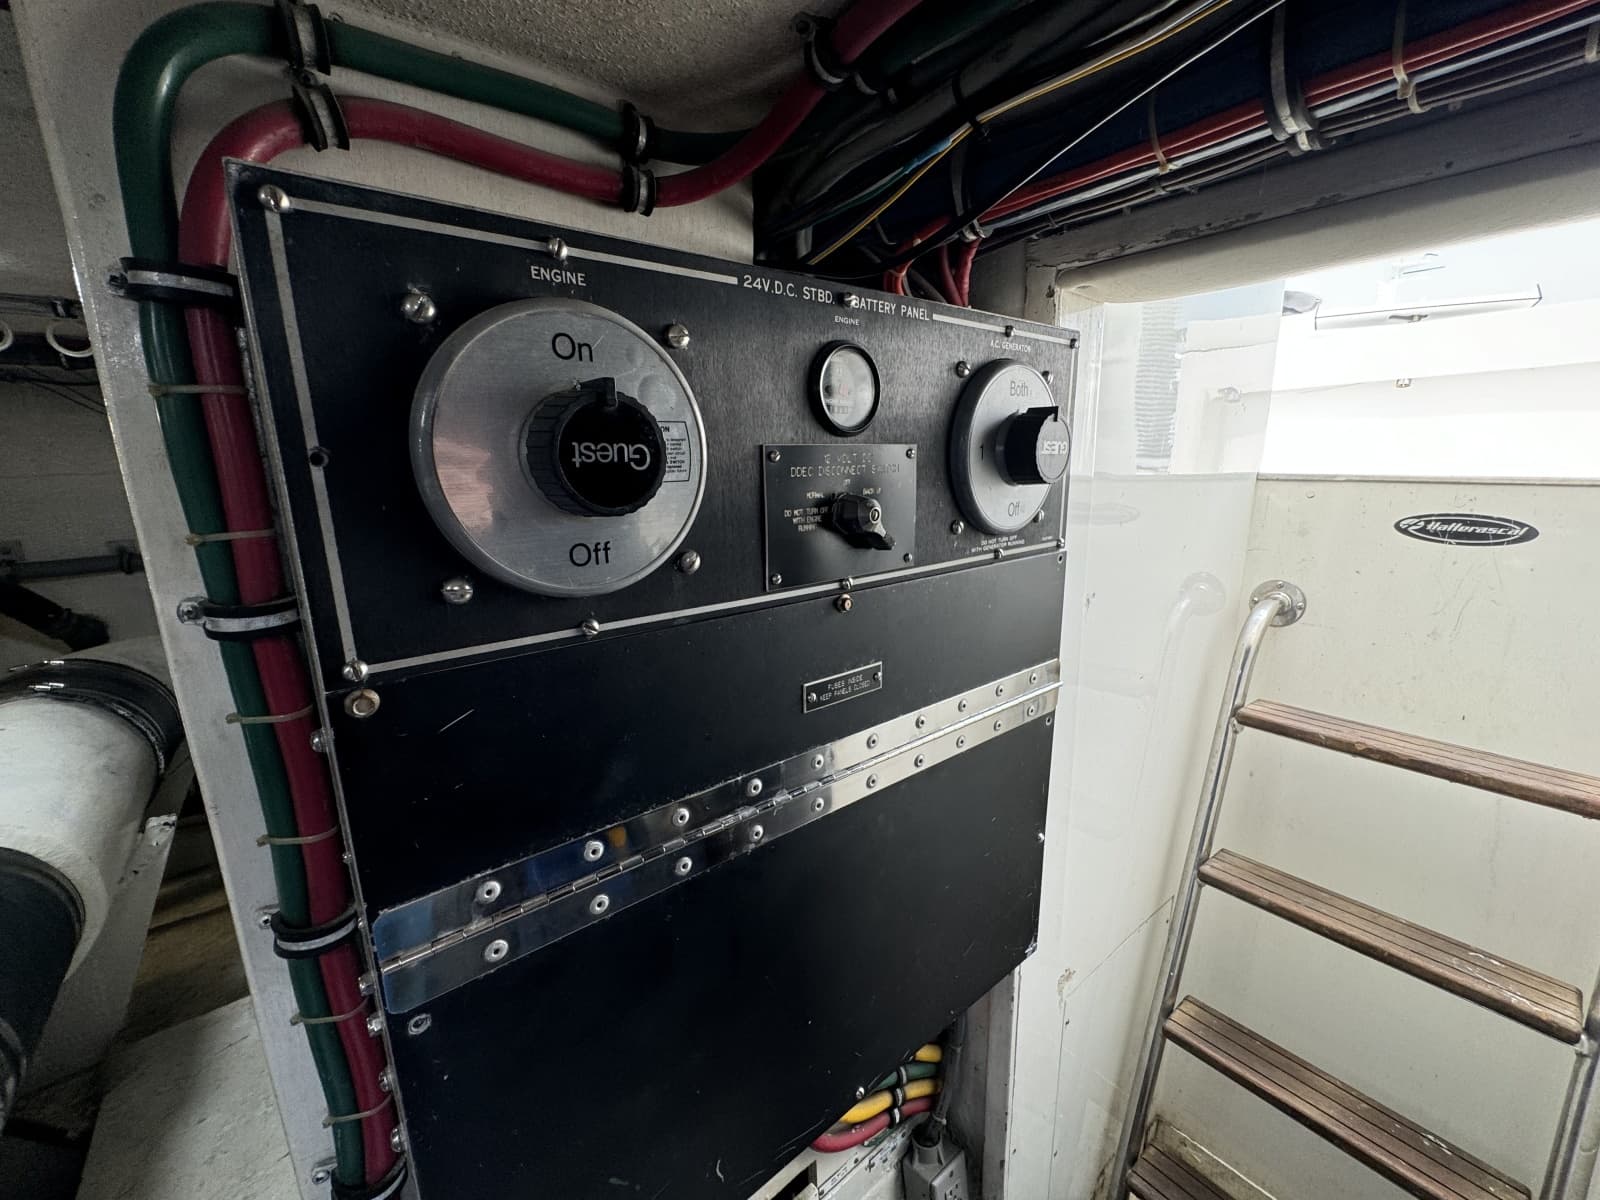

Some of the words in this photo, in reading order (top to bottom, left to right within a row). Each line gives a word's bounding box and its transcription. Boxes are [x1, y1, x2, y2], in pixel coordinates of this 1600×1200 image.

[530, 265, 587, 286] ENGINE
[743, 274, 798, 298] 24V.D.C.
[803, 286, 836, 305] STBD.
[852, 295, 896, 315] BATTERY
[901, 304, 930, 321] PANEL
[834, 315, 860, 326] ENGINE
[552, 332, 594, 362] On
[1010, 380, 1029, 397] Both
[571, 441, 651, 471] Guest
[979, 444, 984, 461] 1
[1041, 440, 1068, 455] GUEST
[790, 466, 814, 478] DDEC
[818, 464, 866, 477] DISCONNECT
[1007, 501, 1020, 517] Off
[569, 541, 611, 567] Off
